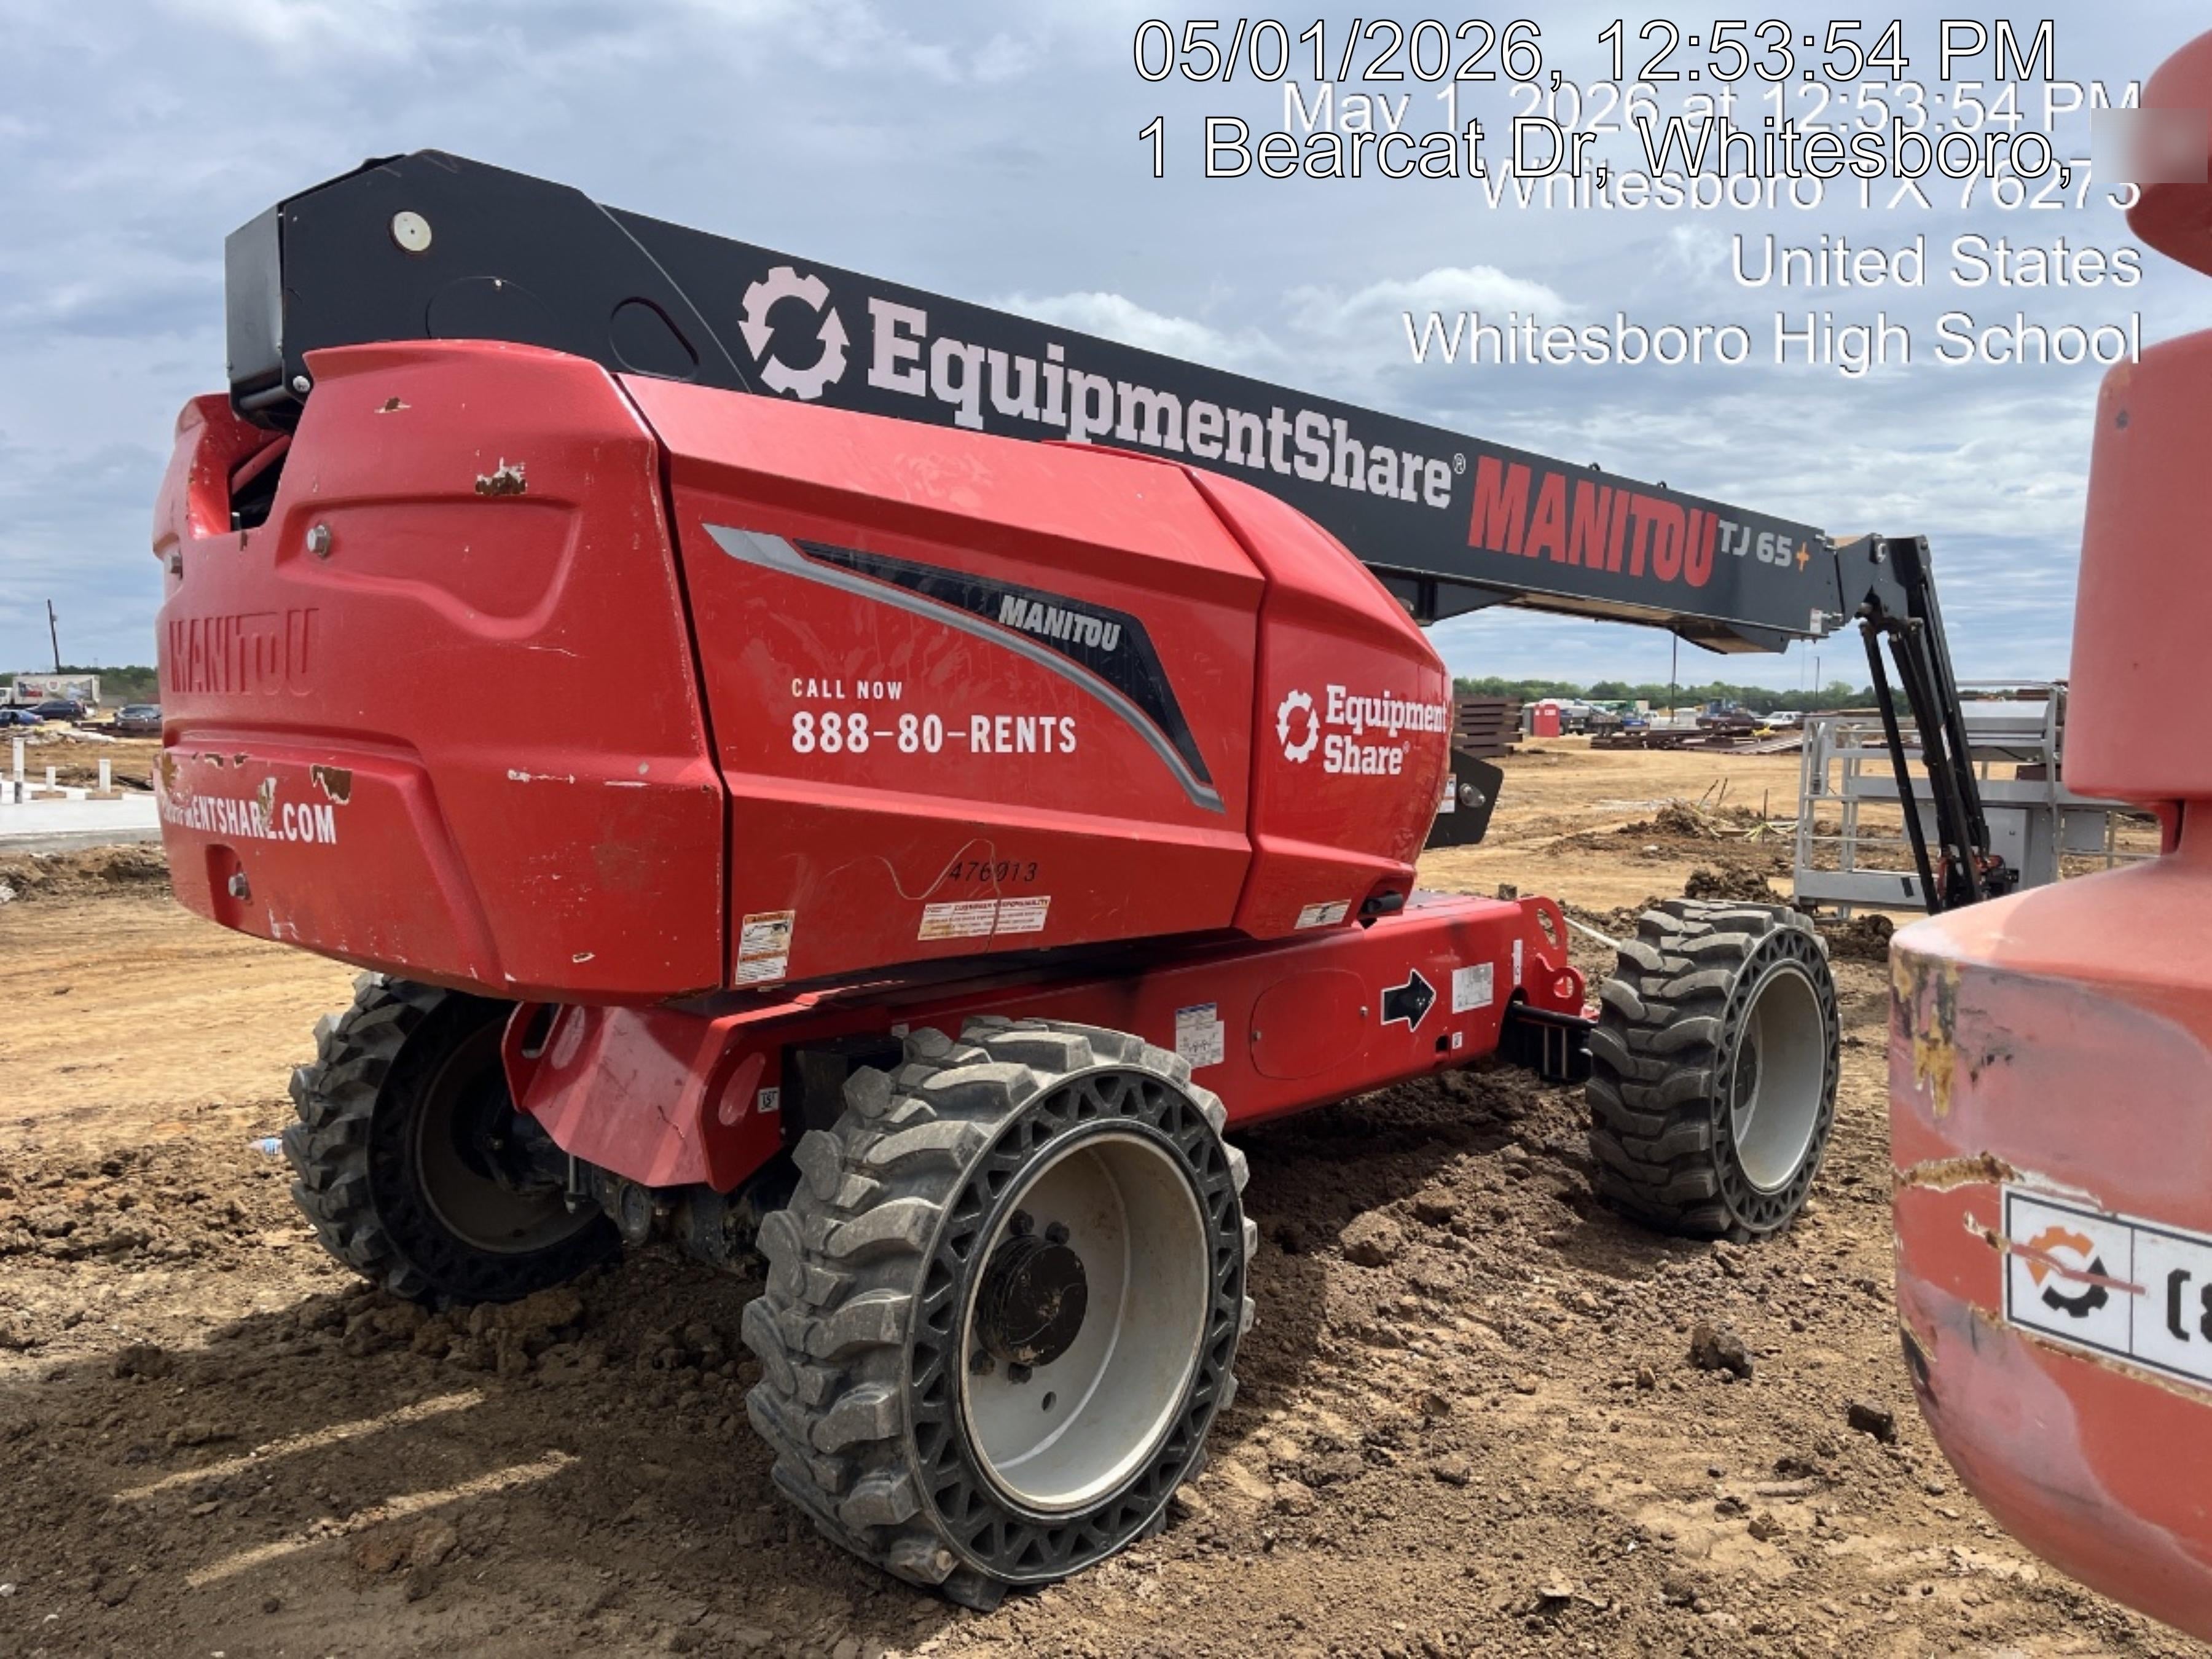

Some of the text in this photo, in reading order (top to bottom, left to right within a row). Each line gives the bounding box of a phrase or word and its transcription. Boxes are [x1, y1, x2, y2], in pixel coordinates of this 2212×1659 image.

[1467, 454, 1721, 588] MANITOU
[1718, 519, 1751, 557] TJ
[998, 594, 1121, 651] MANITOU
[169, 608, 320, 696] MANITOU
[791, 678, 903, 700] CALL NOW
[1325, 683, 1447, 737] Equipment
[791, 711, 1077, 753] 888-80-RENTS
[949, 861, 1038, 882] 476013
